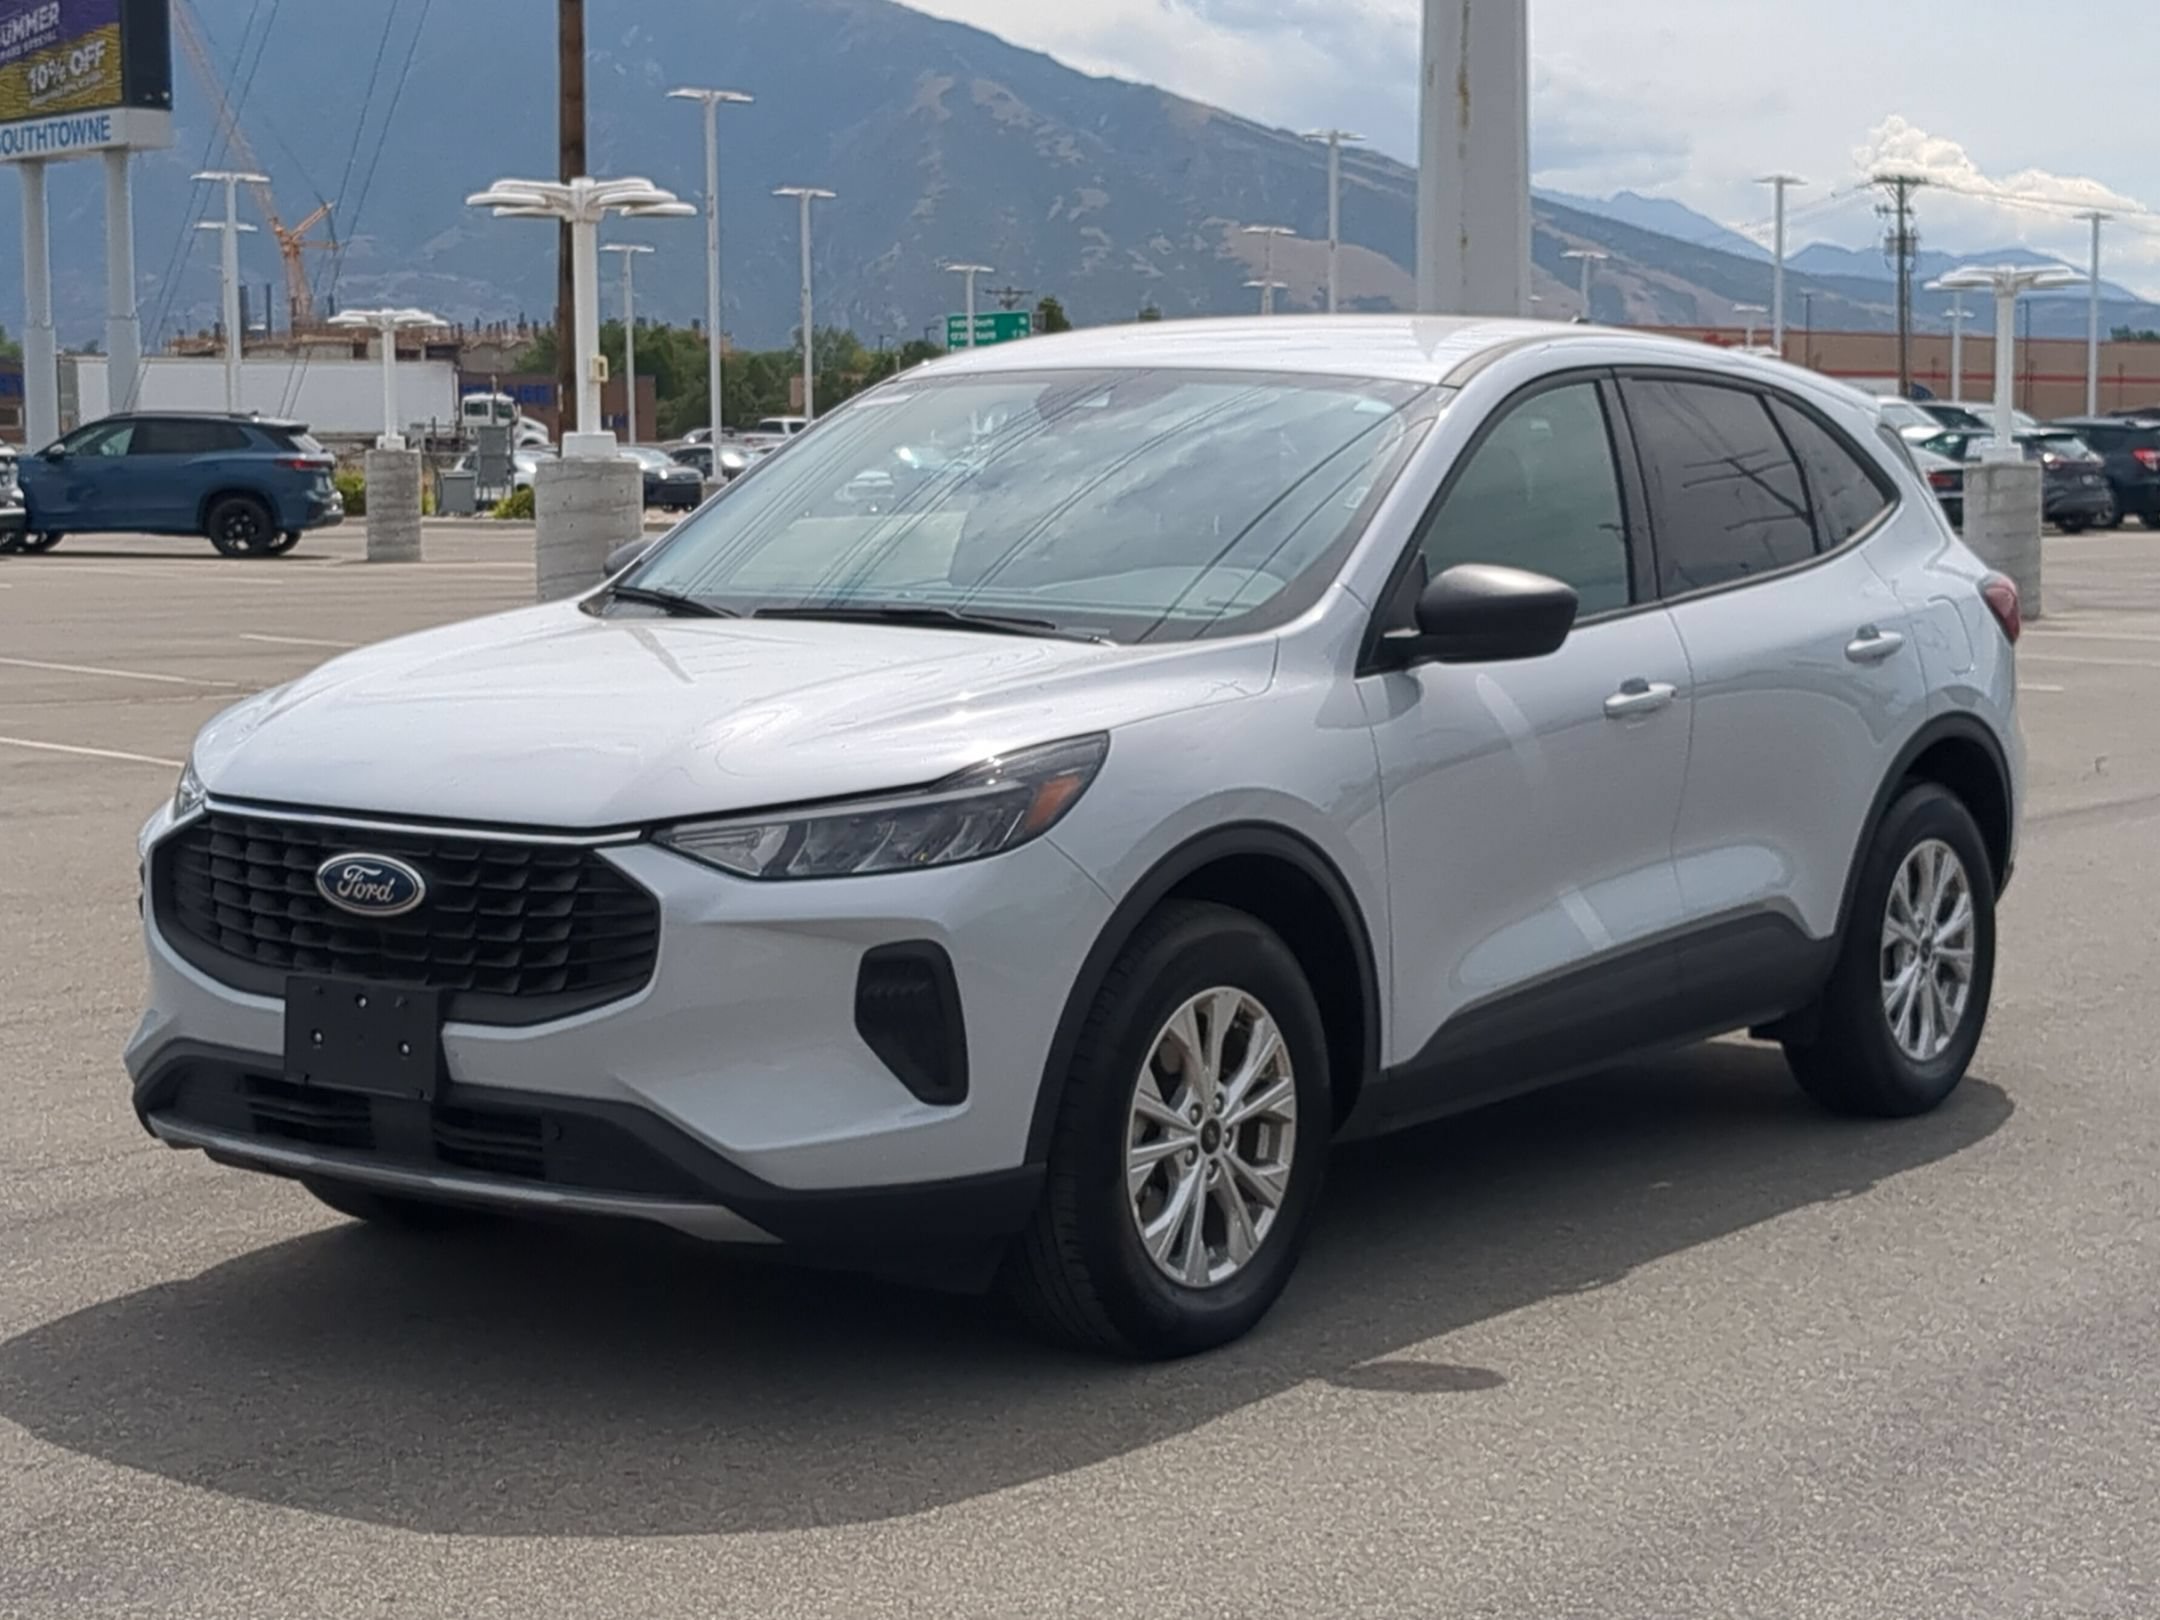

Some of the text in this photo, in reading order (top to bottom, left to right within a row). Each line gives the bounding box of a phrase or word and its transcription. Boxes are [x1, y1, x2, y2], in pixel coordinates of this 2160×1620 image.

[0, 1, 60, 48] UMMER
[28, 58, 66, 93] 10%
[70, 40, 106, 77] OFF
[0, 115, 111, 156] OUTHTOWNE
[337, 864, 396, 902] Ford
